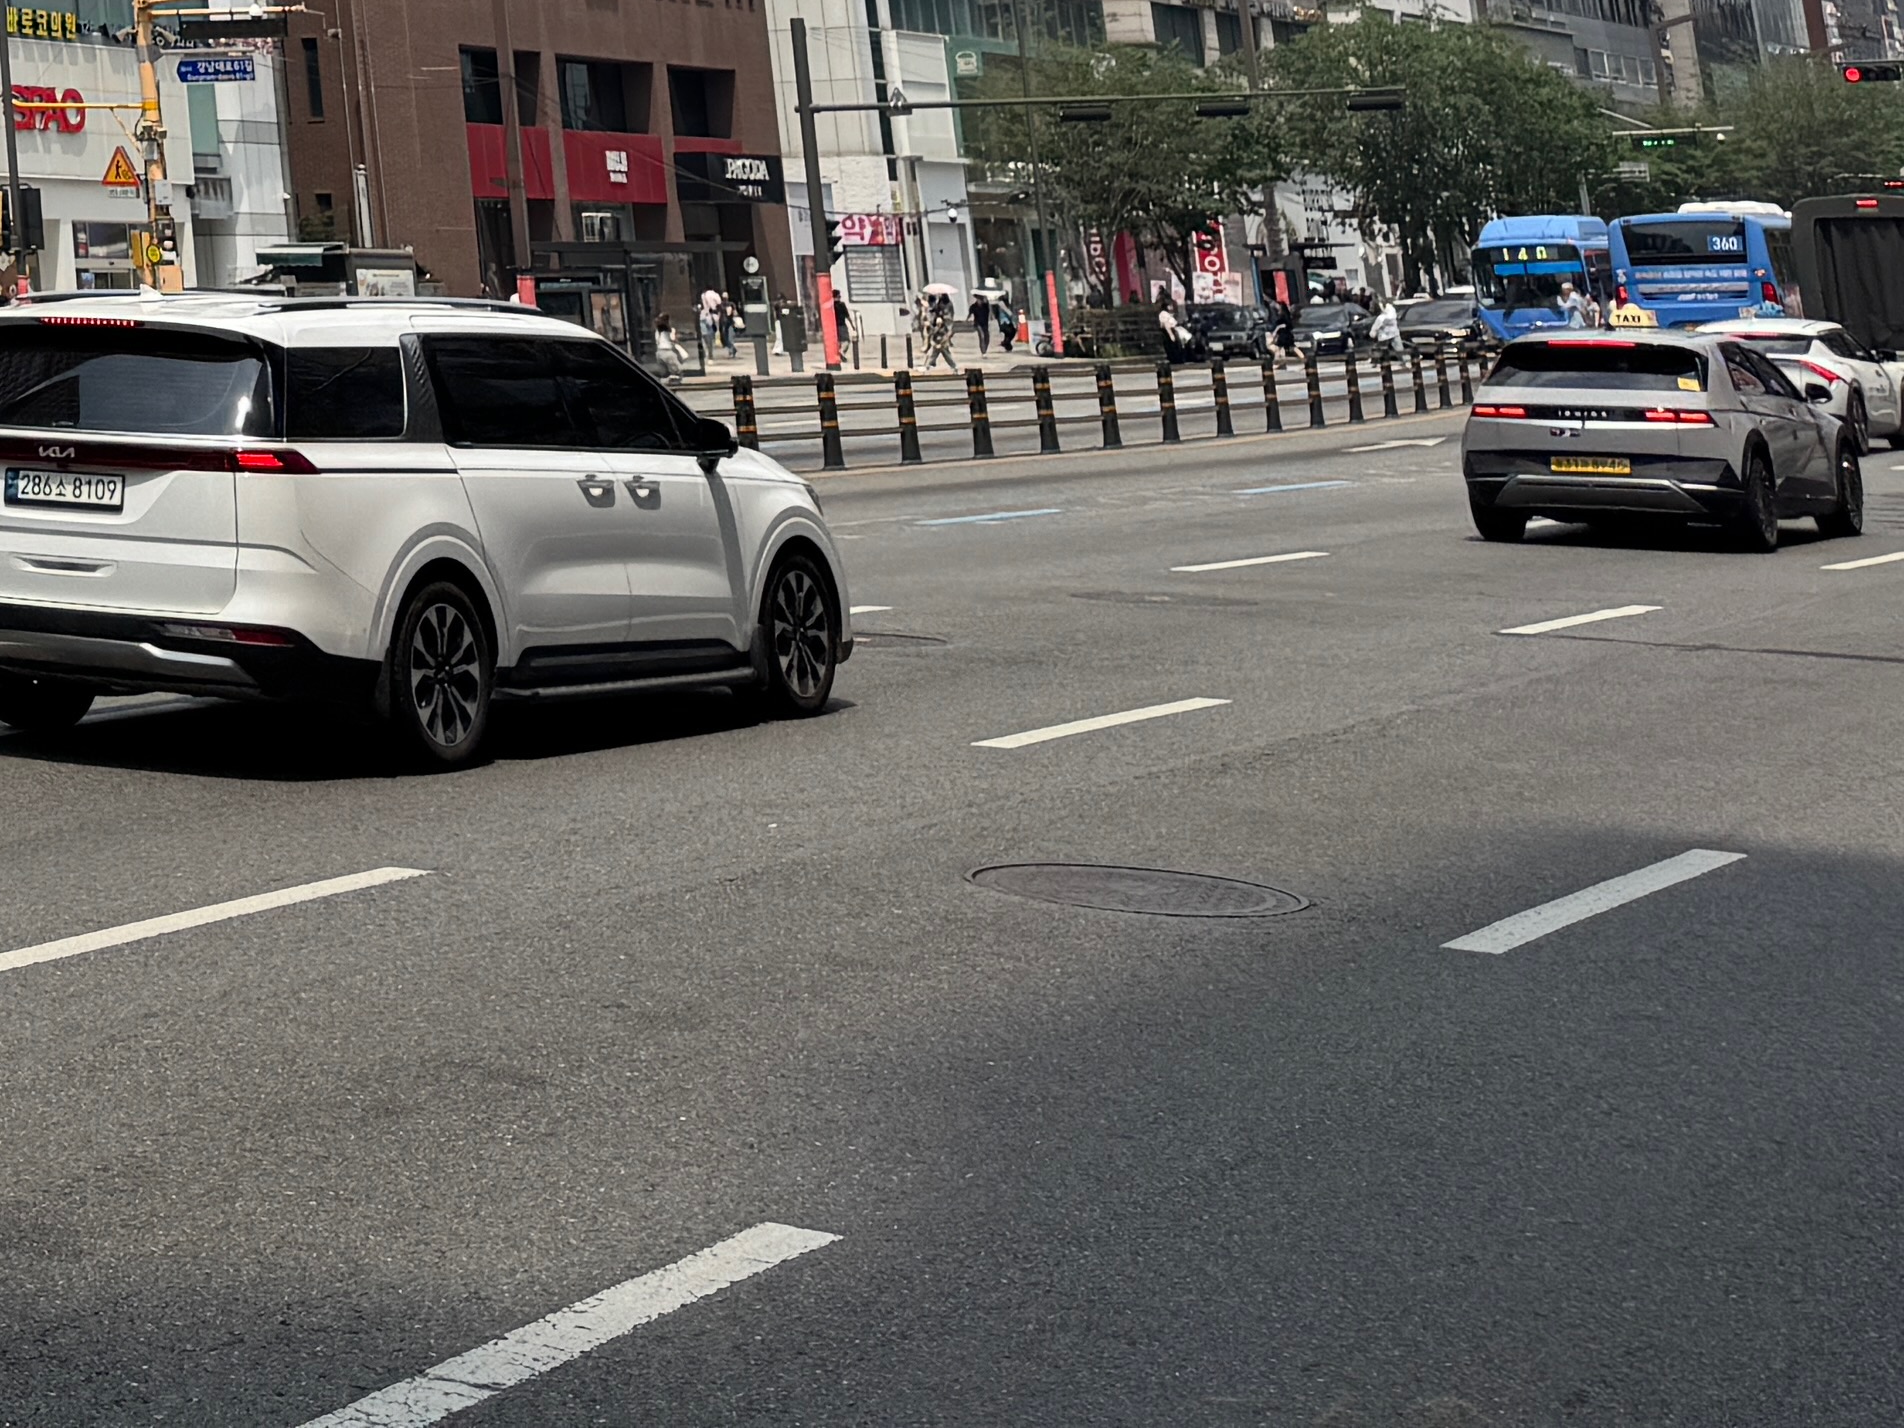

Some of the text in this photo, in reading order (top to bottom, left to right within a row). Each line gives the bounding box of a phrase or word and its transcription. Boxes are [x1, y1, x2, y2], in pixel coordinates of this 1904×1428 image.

[6, 6, 77, 40] 바로코의원
[11, 83, 86, 134] SPAO
[724, 157, 770, 181] PAGODA
[1712, 236, 1738, 251] 360
[1615, 314, 1641, 324] TAXI
[20, 474, 118, 502] 286소 8109
